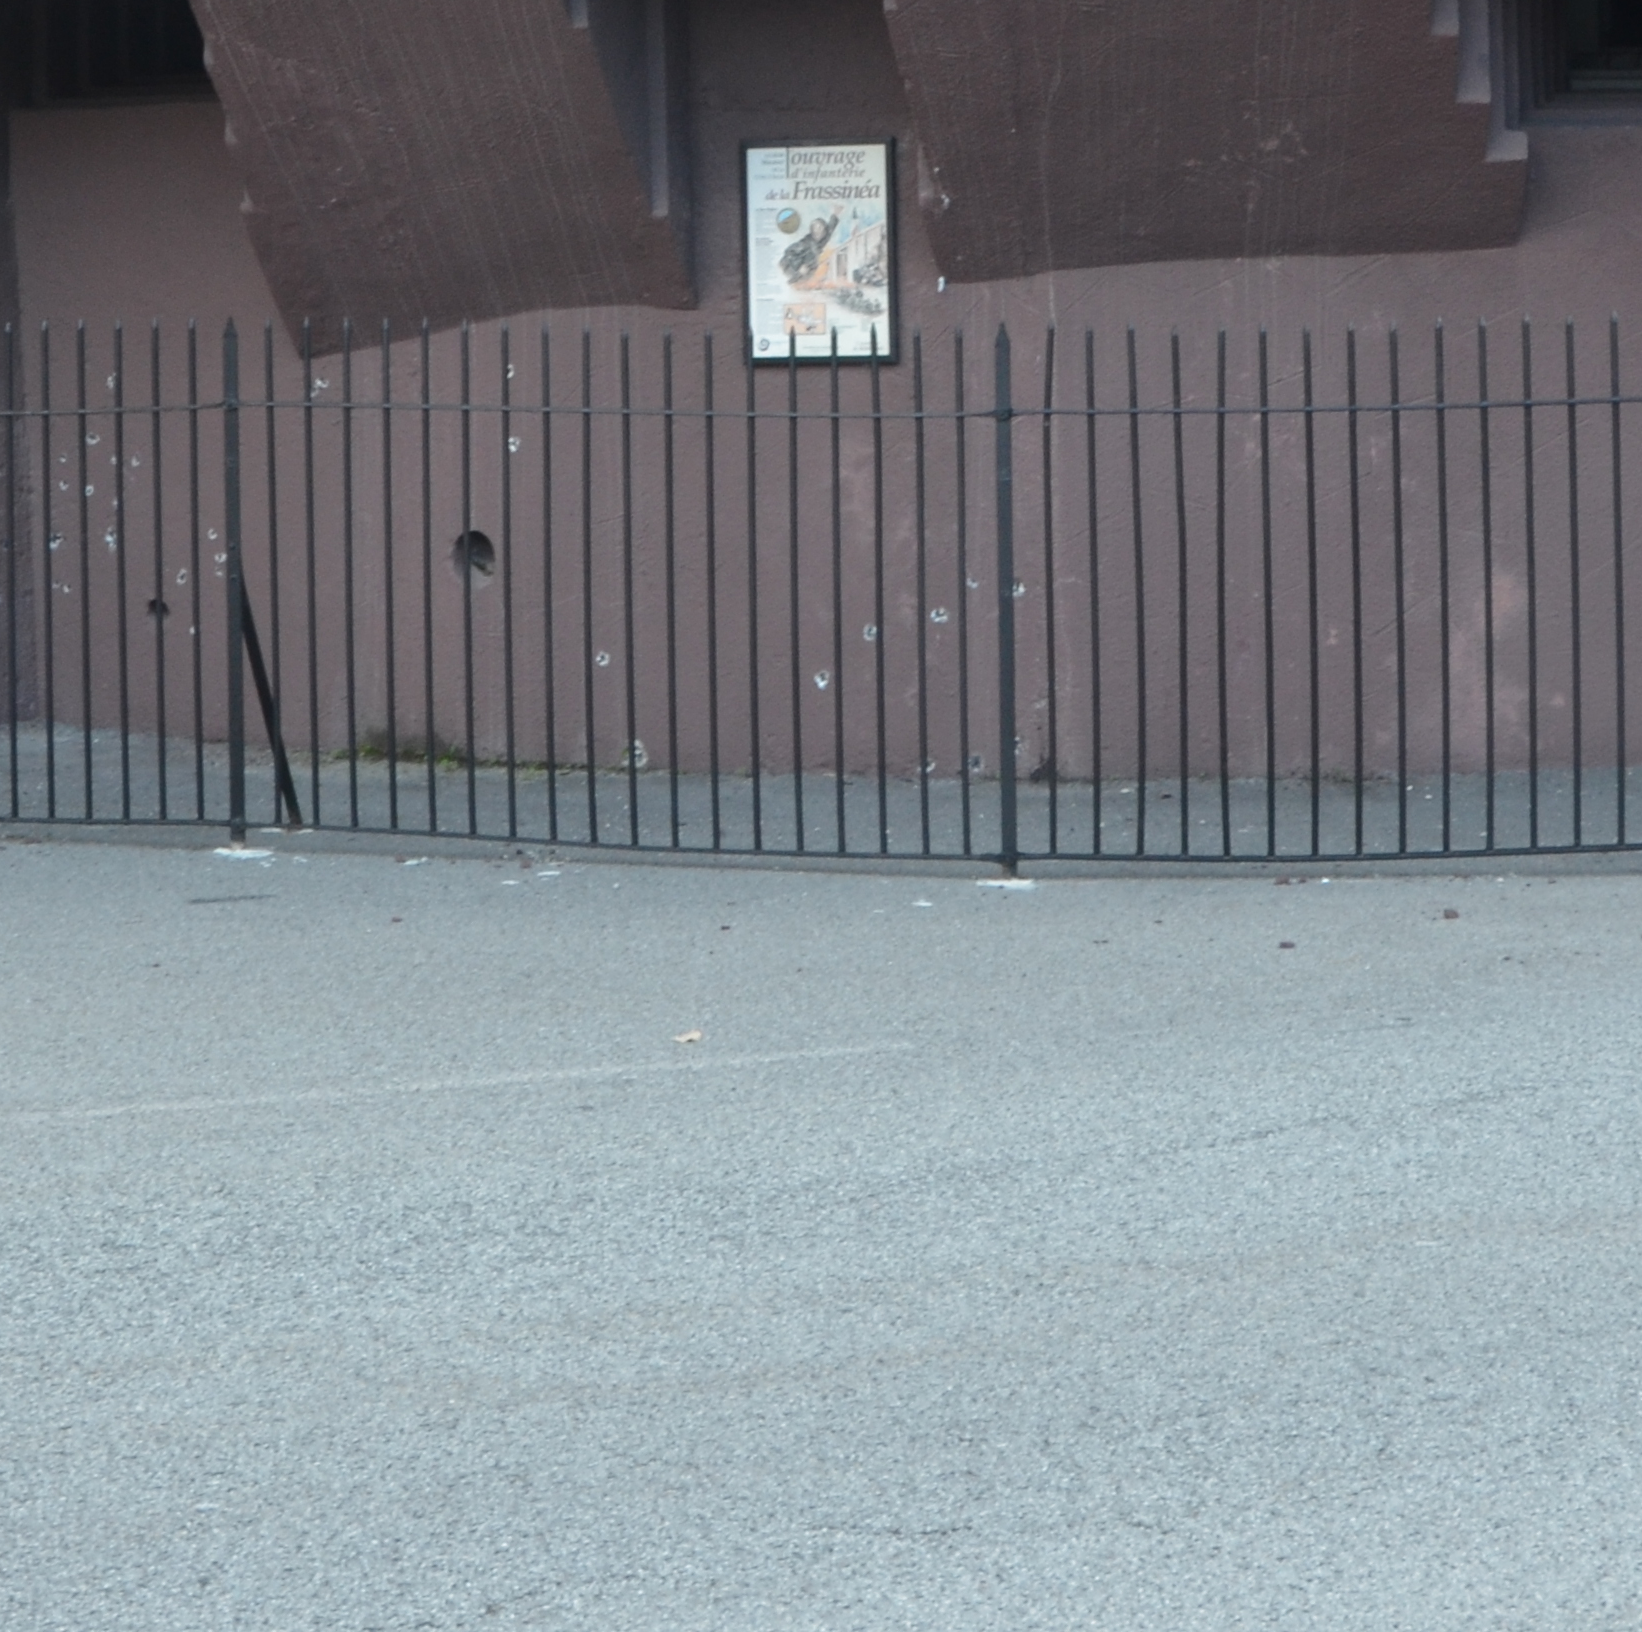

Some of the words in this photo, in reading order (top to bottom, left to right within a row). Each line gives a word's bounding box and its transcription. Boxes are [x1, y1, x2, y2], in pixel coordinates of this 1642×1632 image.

[791, 151, 865, 168] ouvrage
[765, 189, 777, 200] de
[780, 189, 790, 200] la
[792, 179, 881, 200] Frassinéa
